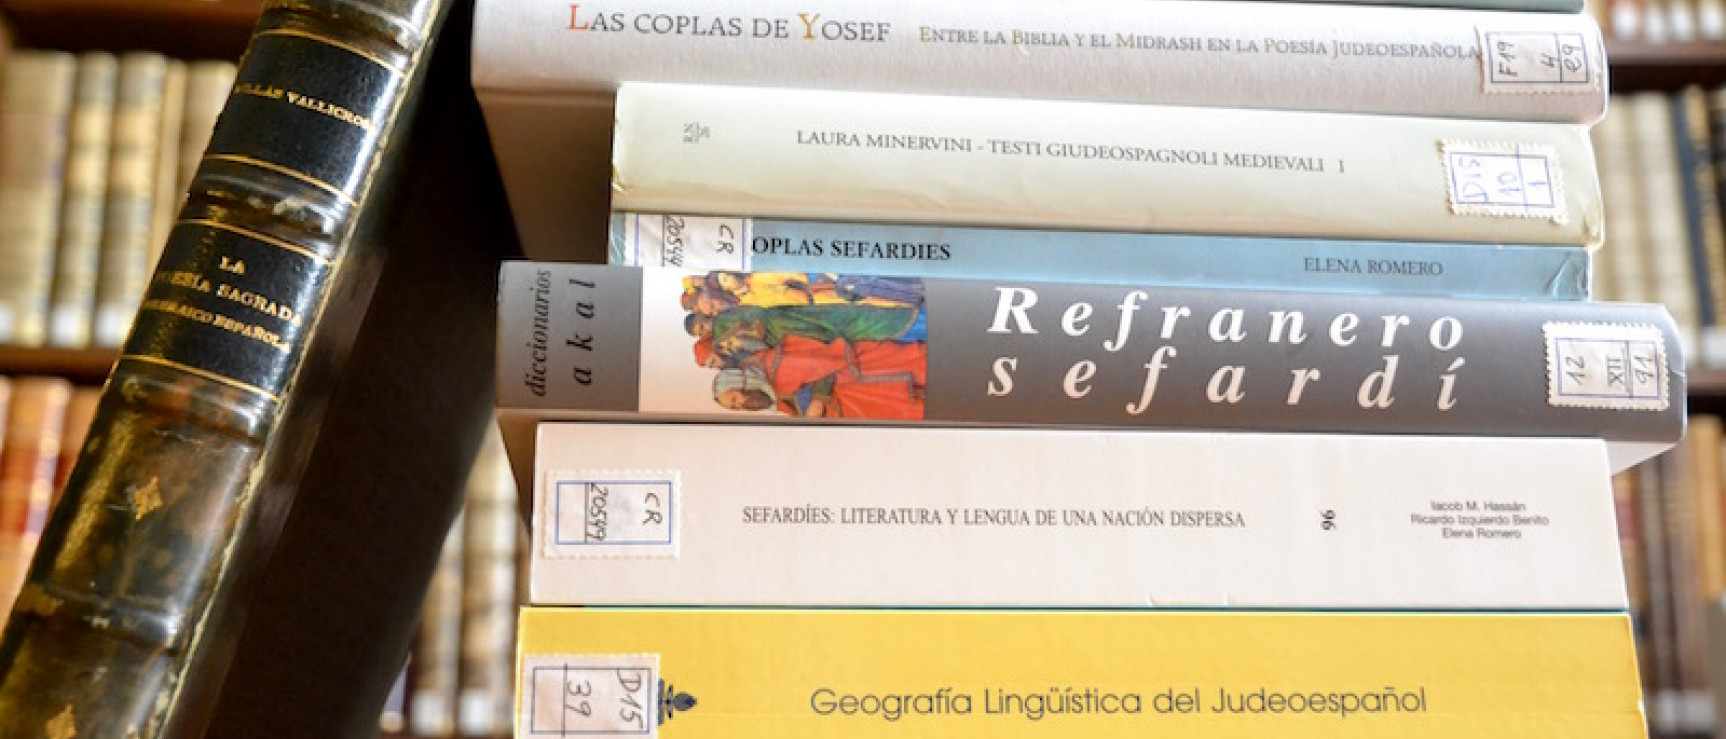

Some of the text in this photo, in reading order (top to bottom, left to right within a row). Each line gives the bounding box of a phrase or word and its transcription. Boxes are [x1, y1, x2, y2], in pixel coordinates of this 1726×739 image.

[567, 4, 891, 42] LAS COPLAS DE YOSEF
[919, 26, 1482, 60] ENTRE LA BIBLIA Y EL MIDRASH EN LA POESÍA JUDEOESPAÑOLA
[287, 91, 377, 132] VALLICROS
[797, 130, 861, 147] LAURA
[866, 134, 972, 153] MINERVINI
[987, 139, 1041, 156] TESTI
[1045, 142, 1217, 166] GIUDEOSPAGNOLI
[1223, 152, 1325, 172] MEDIEVALI
[716, 223, 734, 254] CR
[752, 236, 951, 261] OPLAS SEFARDIES
[219, 255, 246, 275] LA
[1303, 257, 1444, 276] ELENA ROMERO
[524, 269, 550, 396] diccionarios
[986, 286, 1465, 352] Refranero
[986, 346, 1466, 415] sefardí
[1565, 356, 1585, 385] 12
[643, 492, 662, 525] CR
[742, 503, 1246, 527] SEFARDÍES: LITERATURA Y LENGUA DE UNA NACIÓN DISPERSA
[1320, 509, 1337, 531] 96
[1410, 514, 1549, 526] Ricardo Izquierdo Benito
[1466, 501, 1480, 511] M.
[1484, 501, 1526, 511] Hassán
[1442, 528, 1522, 538] Elena Romero
[564, 679, 592, 718] 39
[810, 686, 1427, 722] Geografía Lingüística del Judeoespañol
